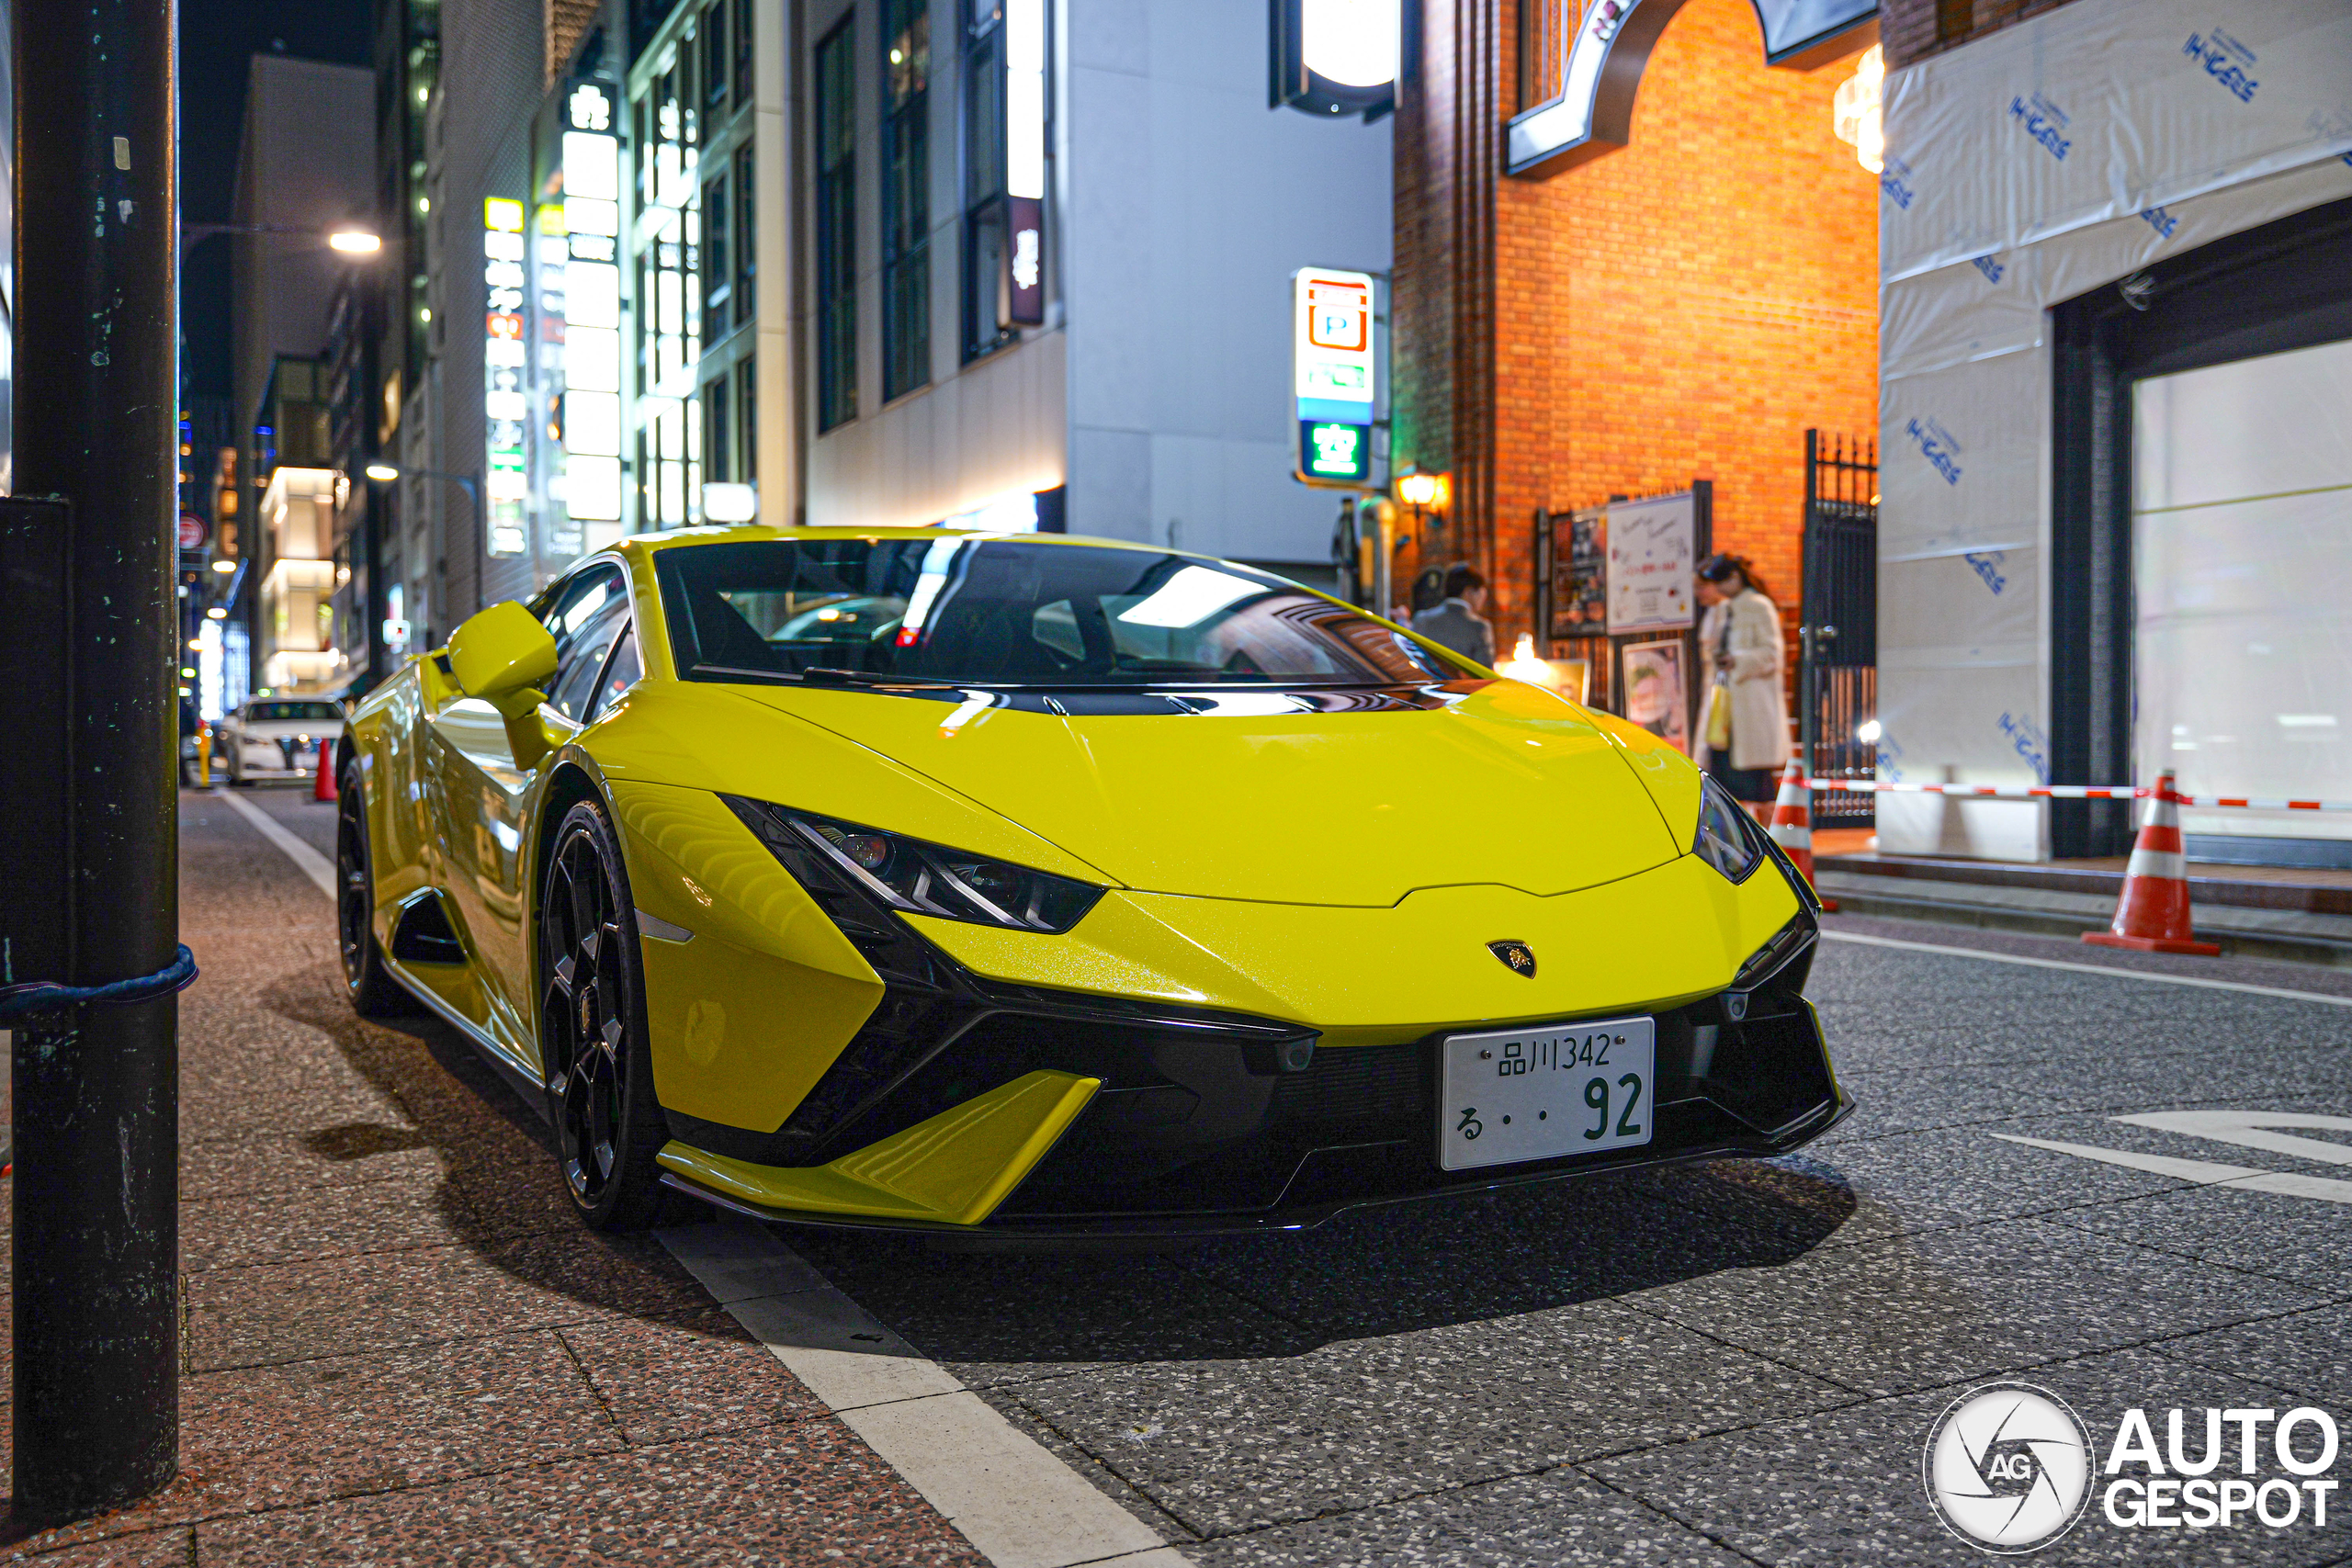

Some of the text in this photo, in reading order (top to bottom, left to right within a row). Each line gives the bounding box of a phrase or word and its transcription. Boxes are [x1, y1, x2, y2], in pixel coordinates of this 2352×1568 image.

[1326, 316, 1347, 335] P
[1312, 423, 1358, 474] 空
[1456, 1107, 1483, 1140] る
[1583, 1072, 1642, 1140] 92
